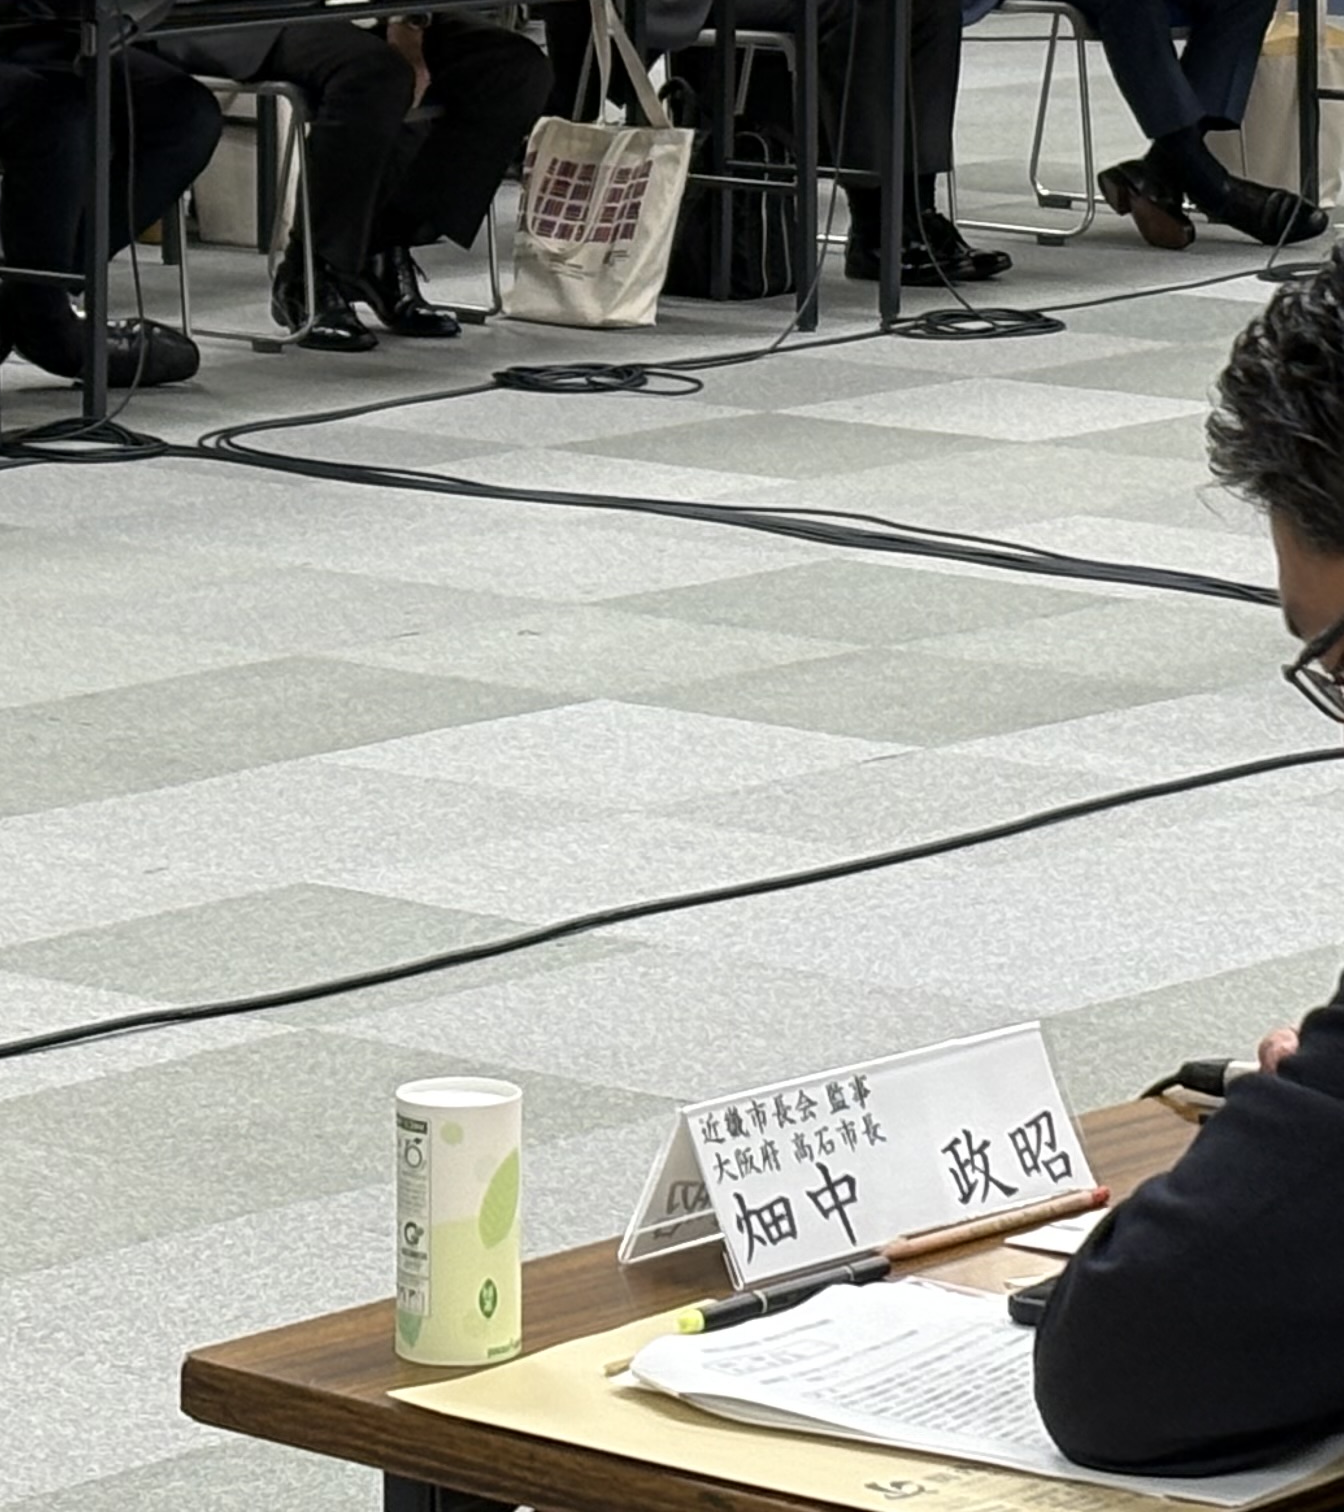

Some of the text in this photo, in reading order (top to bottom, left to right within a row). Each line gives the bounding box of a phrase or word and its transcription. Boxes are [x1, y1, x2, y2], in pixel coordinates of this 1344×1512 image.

[700, 1074, 872, 1146] 近畿市長会 監事
[713, 1112, 887, 1185] 大阪府 高石市長
[732, 1161, 858, 1265] 畑中
[941, 1109, 1073, 1205] 政昭
